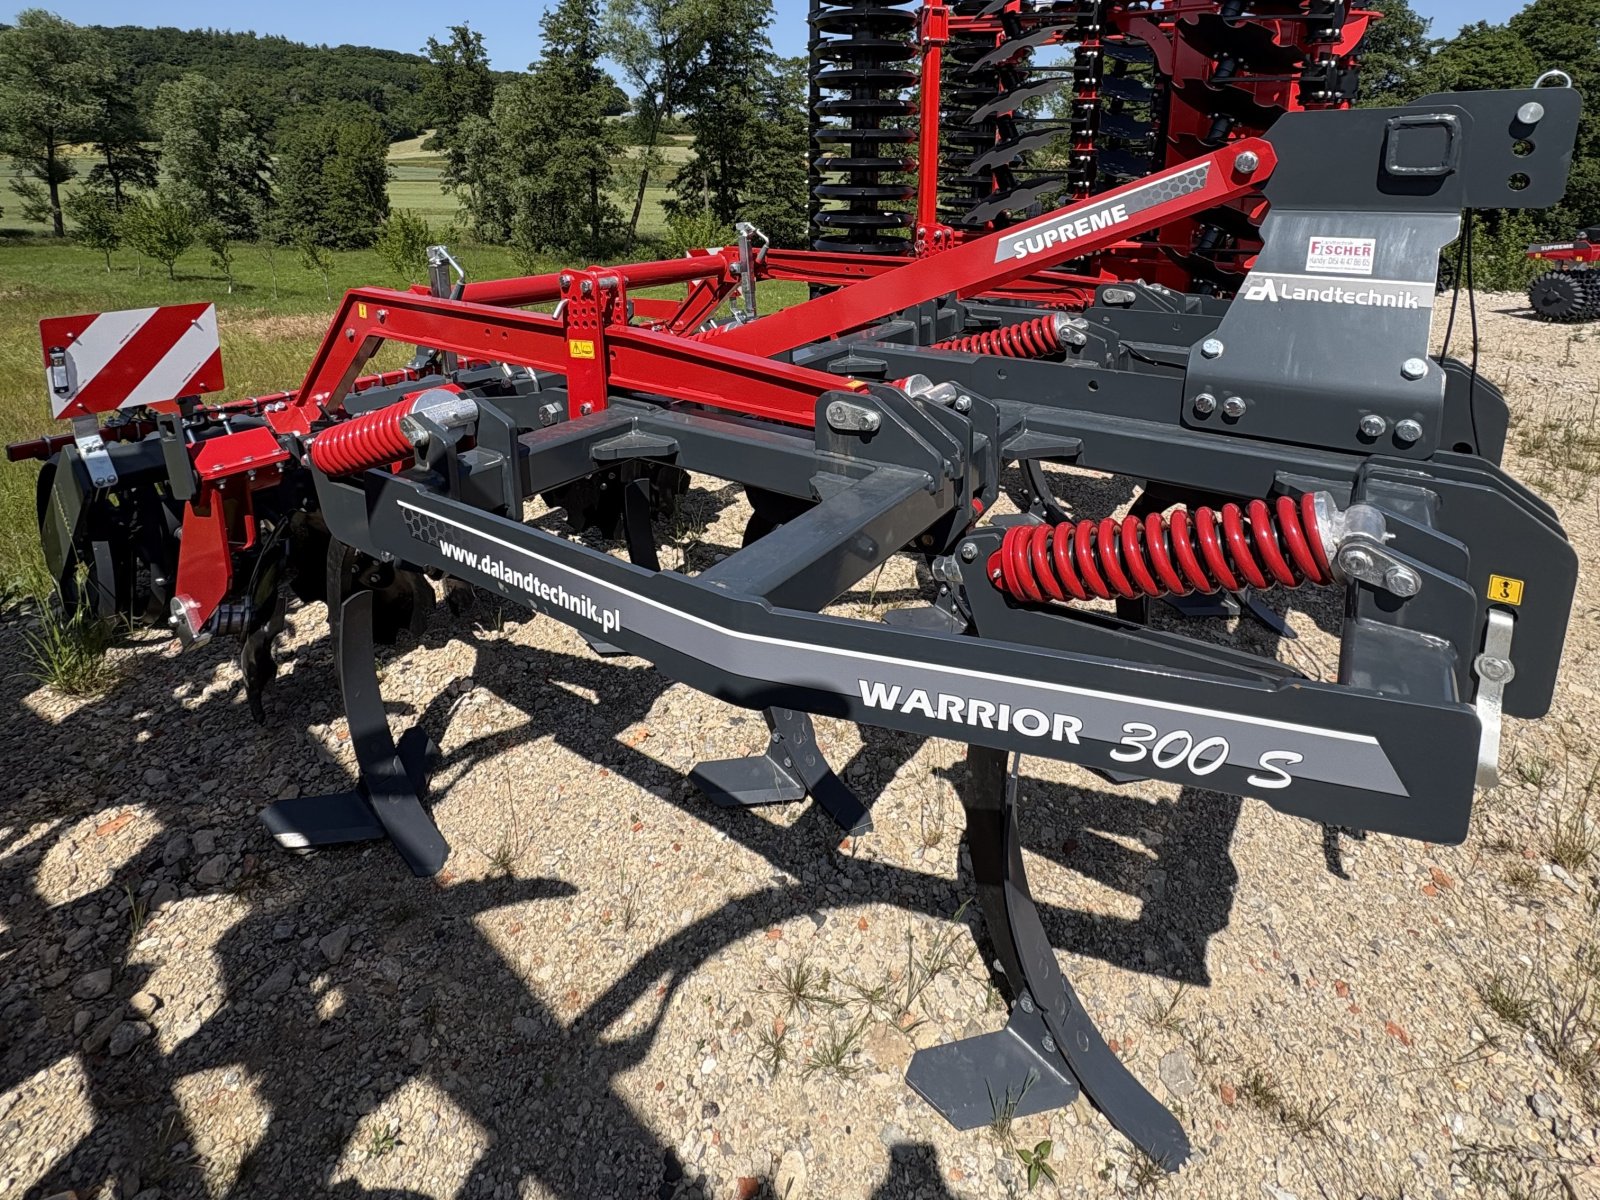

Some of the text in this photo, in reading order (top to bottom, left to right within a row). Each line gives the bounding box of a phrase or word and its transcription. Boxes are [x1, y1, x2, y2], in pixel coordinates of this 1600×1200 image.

[1013, 204, 1129, 259] SUPREME
[1311, 241, 1372, 257] FISCHER
[1541, 243, 1574, 251] SUPREME
[1281, 284, 1418, 309] Landtechnik
[439, 539, 621, 634] www.dalandtechnik.pl
[858, 679, 1304, 789] WARRIOR 300 S
